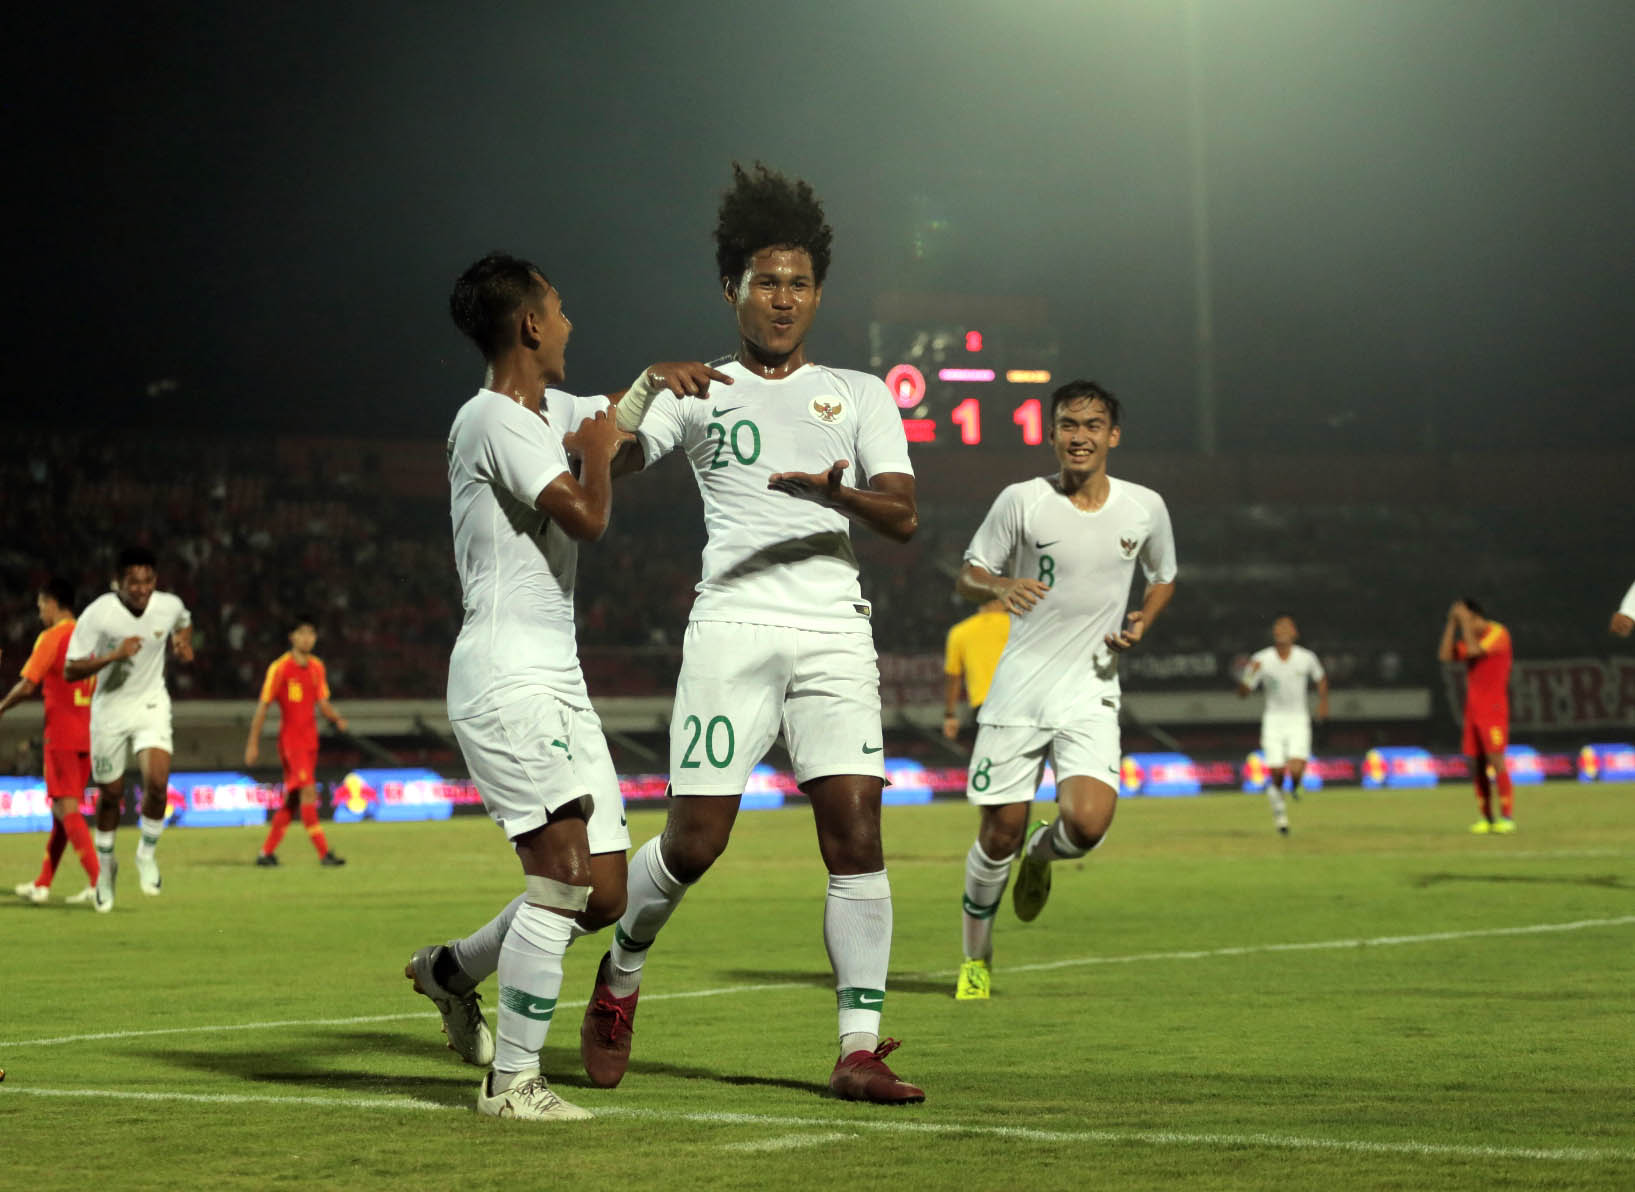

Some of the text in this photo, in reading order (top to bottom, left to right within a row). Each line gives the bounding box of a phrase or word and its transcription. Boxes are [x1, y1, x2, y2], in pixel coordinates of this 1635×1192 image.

[706, 419, 761, 470] 20
[951, 398, 981, 445] 1
[1013, 398, 1042, 445] 1
[1038, 554, 1055, 589] 8
[680, 714, 735, 769] 20
[972, 756, 993, 792] 8
